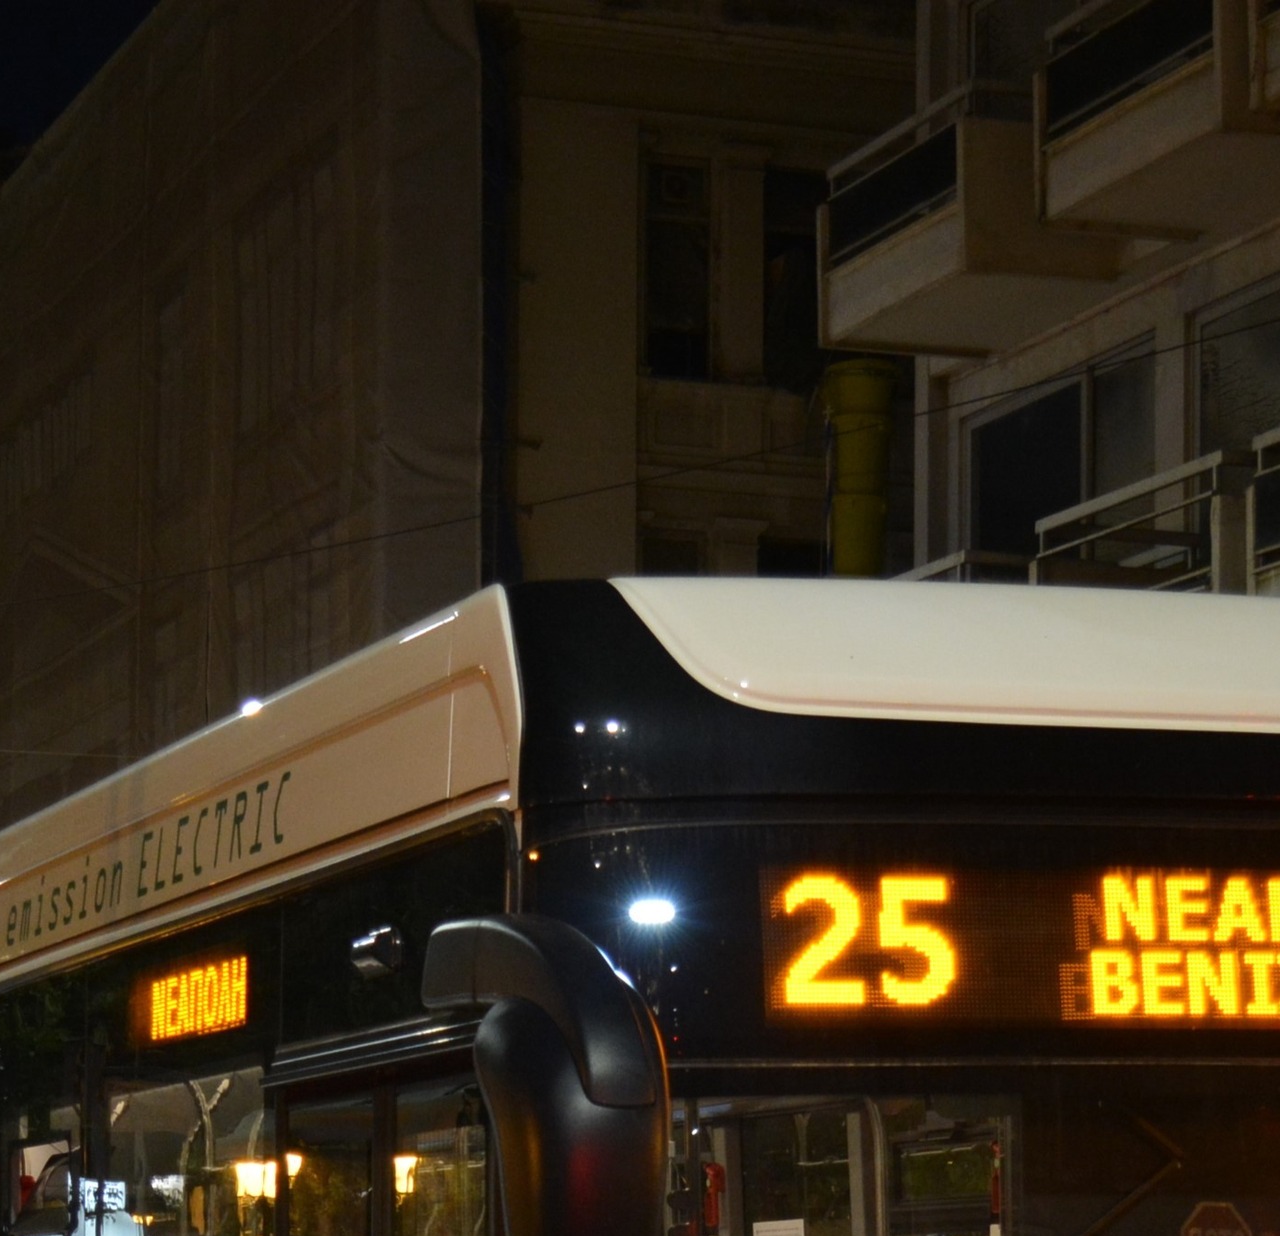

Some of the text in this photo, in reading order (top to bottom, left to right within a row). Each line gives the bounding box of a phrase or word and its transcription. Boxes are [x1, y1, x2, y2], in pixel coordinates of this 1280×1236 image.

[6, 856, 123, 946] emission
[136, 771, 291, 898] ELECTRIC
[151, 956, 247, 1040] ΝΕΑΠΟΛΗ
[784, 876, 956, 1005] 25
